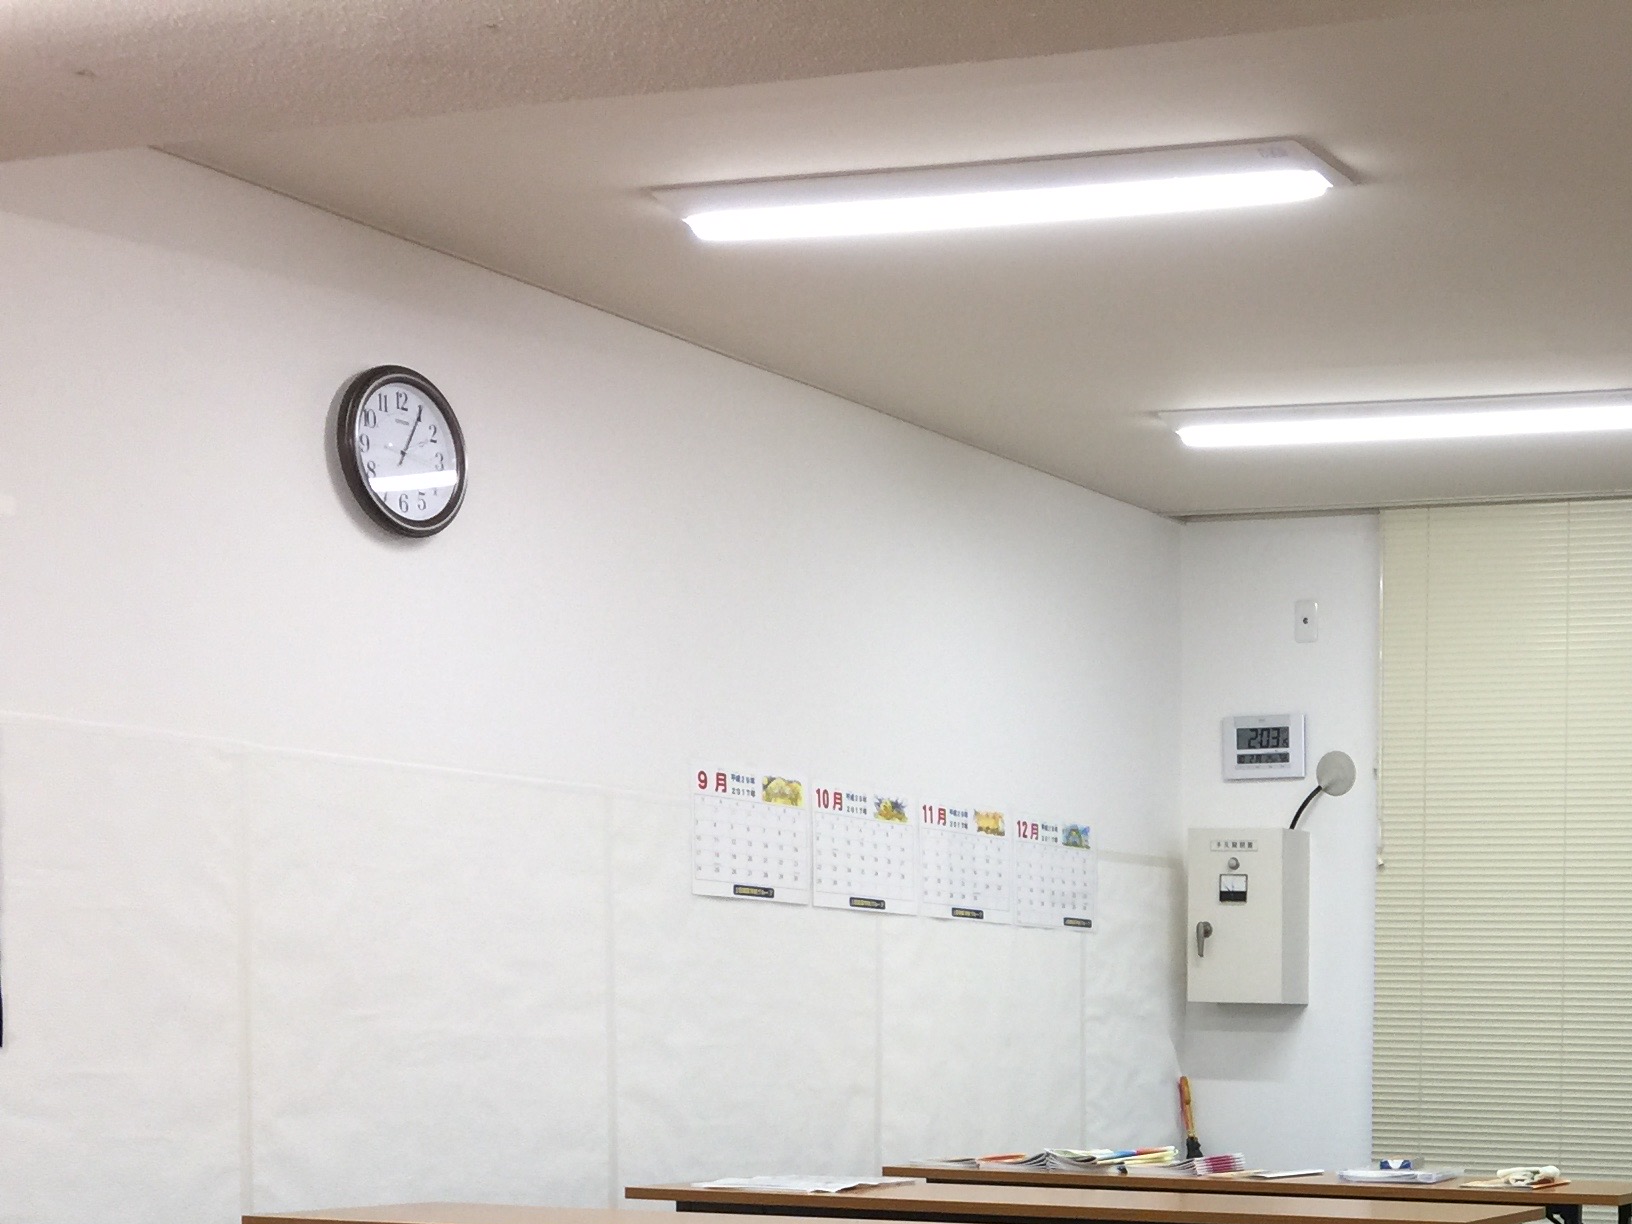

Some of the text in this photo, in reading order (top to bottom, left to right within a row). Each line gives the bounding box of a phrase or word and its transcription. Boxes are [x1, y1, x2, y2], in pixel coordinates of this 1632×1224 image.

[378, 393, 388, 412] 11
[396, 391, 408, 411] 12
[362, 409, 376, 428] 10
[417, 405, 423, 422] 1
[359, 434, 369, 452] 9
[429, 425, 437, 443] 2
[367, 461, 376, 478] 8
[435, 453, 443, 471] 3
[399, 494, 409, 512] 6
[418, 492, 426, 510] 5
[698, 770, 727, 793] 9月
[816, 788, 843, 811] 10月
[922, 805, 946, 826] 11月
[1017, 820, 1039, 840] 12月
